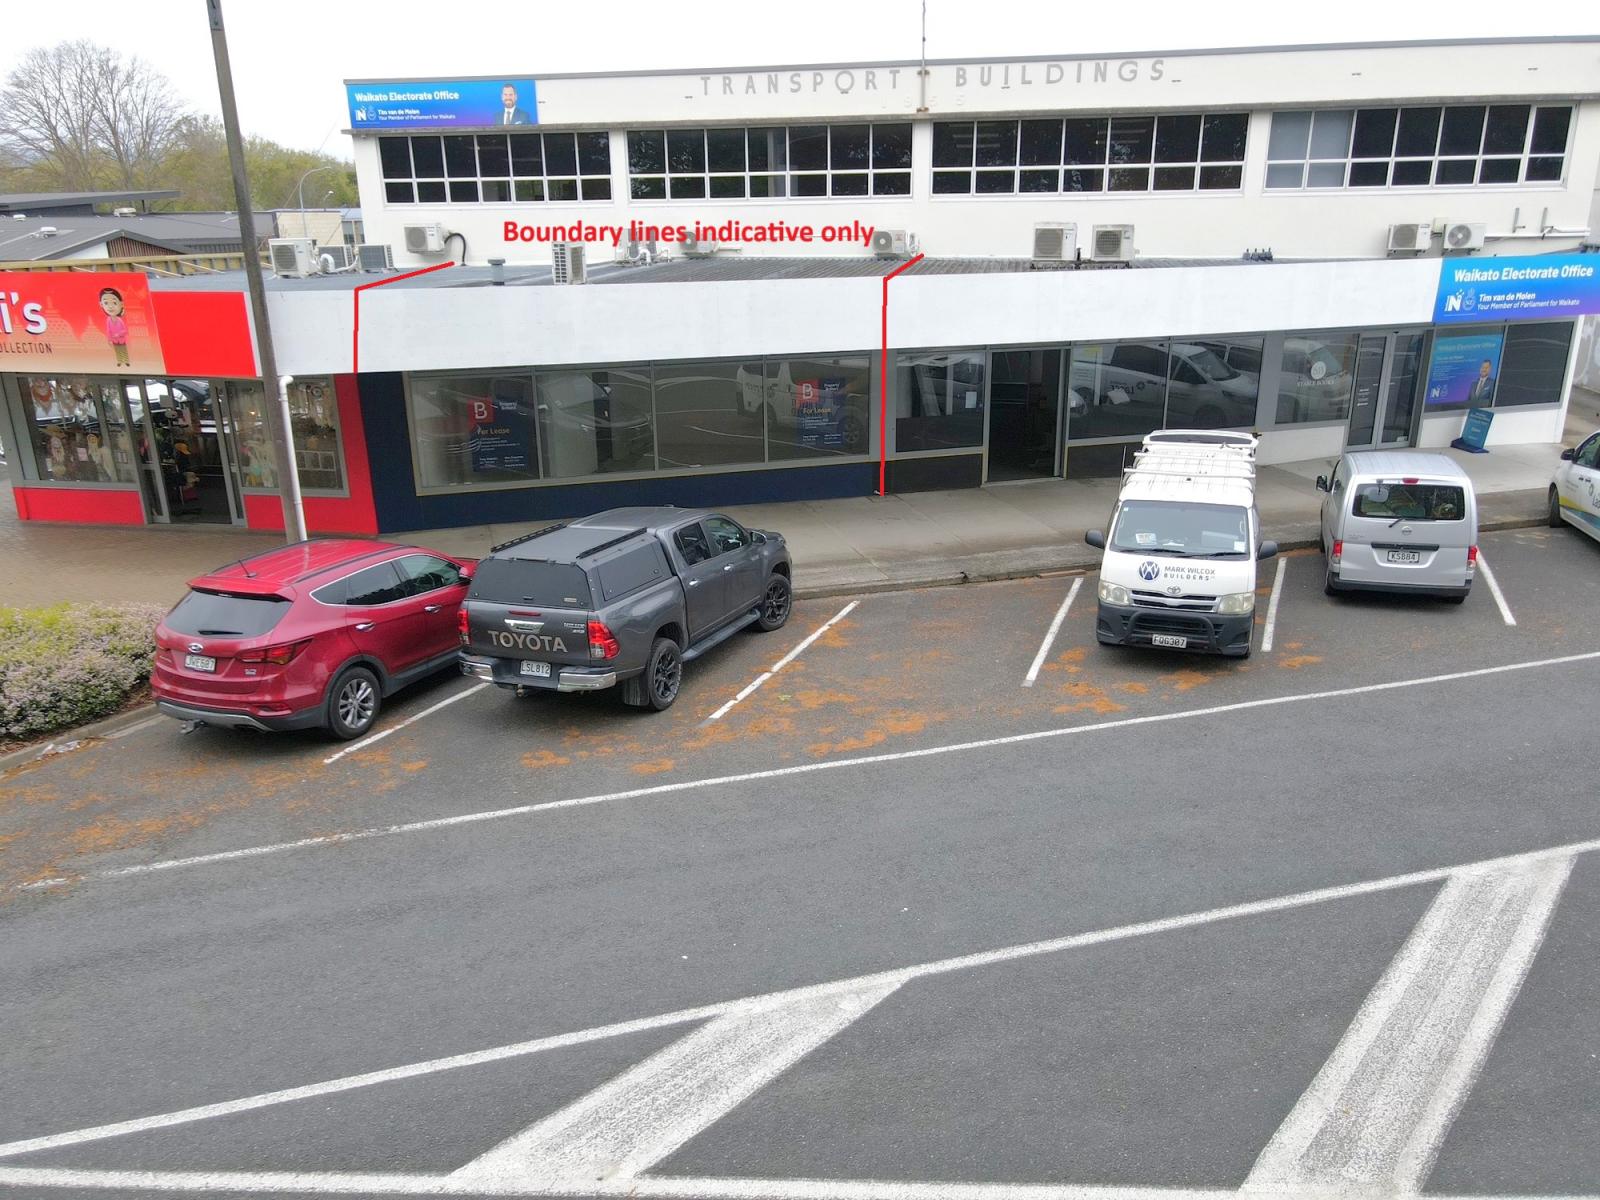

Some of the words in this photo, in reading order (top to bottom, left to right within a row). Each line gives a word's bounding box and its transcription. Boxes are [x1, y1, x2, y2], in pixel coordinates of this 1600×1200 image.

[700, 69, 901, 96] TRANSPORT
[955, 59, 1165, 87] BUILDINGS
[354, 92, 388, 102] Waikato
[389, 91, 432, 101] Electorate
[433, 90, 460, 100] Office
[1454, 269, 1499, 282] Waikato
[1501, 266, 1559, 280] Electorate
[1561, 263, 1593, 277] Office
[1479, 293, 1492, 301] Tim
[1506, 292, 1514, 300] de
[1515, 292, 1536, 300] Molen
[0, 291, 48, 335] i's
[802, 383, 813, 399] B
[474, 401, 488, 419] B
[490, 427, 510, 435] Lease
[1163, 573, 1210, 581] BUILDERS
[1164, 565, 1186, 574] MARK
[1187, 567, 1216, 575] WILCOX
[488, 630, 568, 653] TOYOTA
